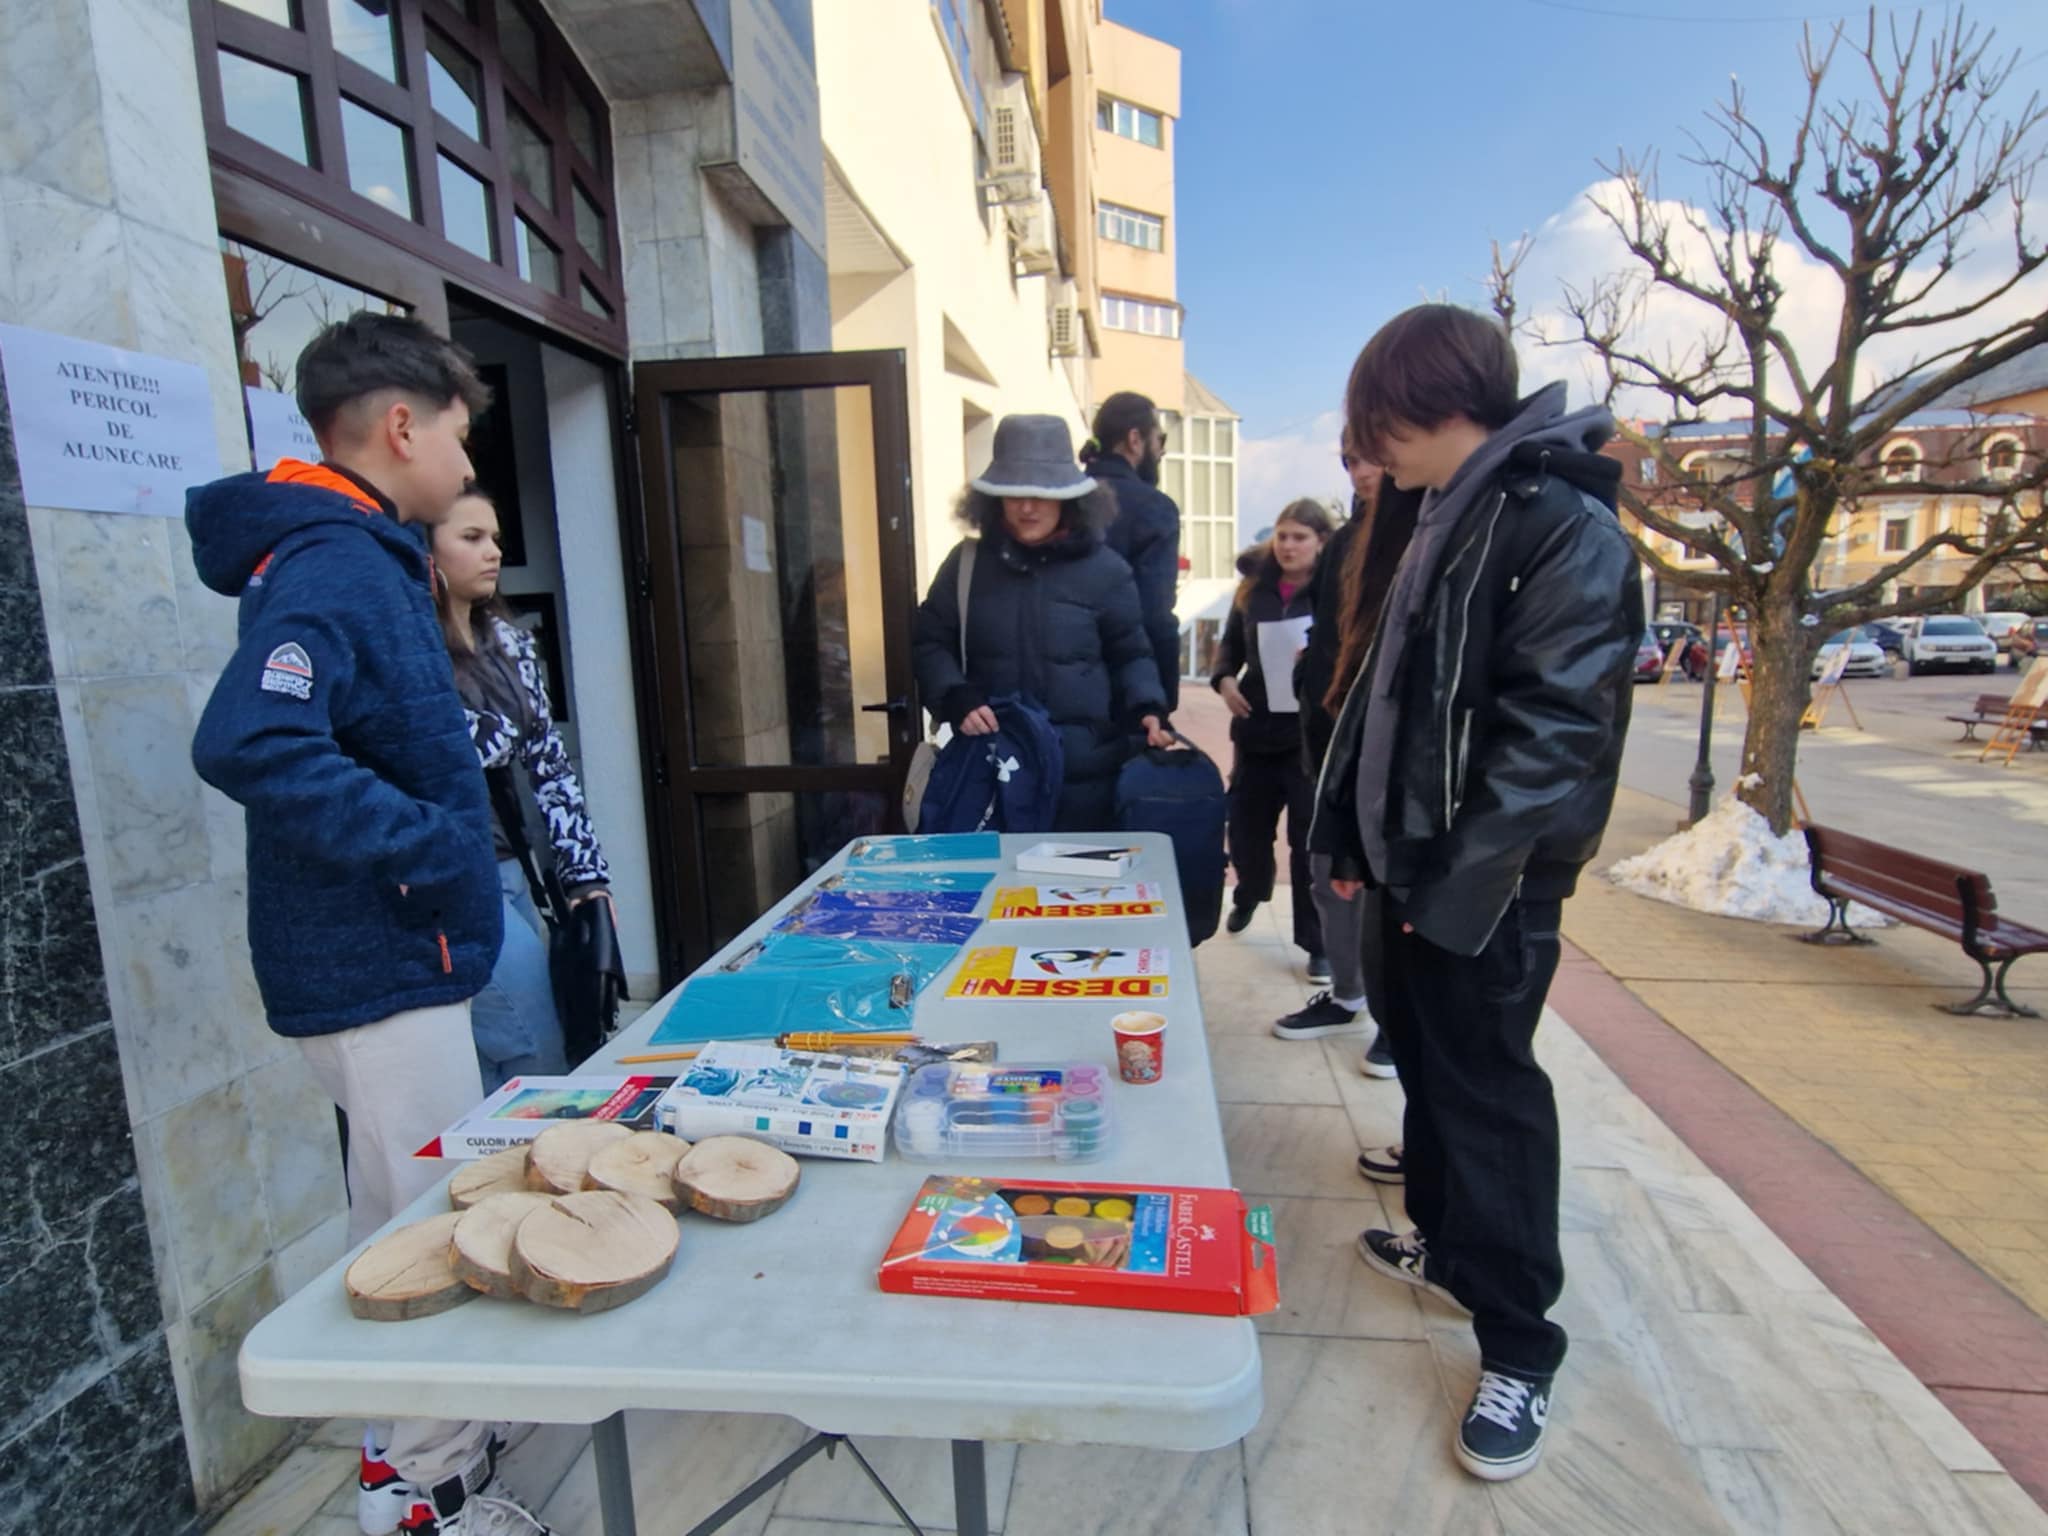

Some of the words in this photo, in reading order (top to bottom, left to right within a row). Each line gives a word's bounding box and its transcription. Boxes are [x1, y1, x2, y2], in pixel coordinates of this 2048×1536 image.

[70, 389, 158, 419] PERICOL
[106, 420, 134, 440] DE
[62, 442, 183, 472] ALUNECARE
[1016, 903, 1153, 918] DESEN
[979, 978, 1151, 997] DESEN
[466, 1137, 506, 1147] CULORI
